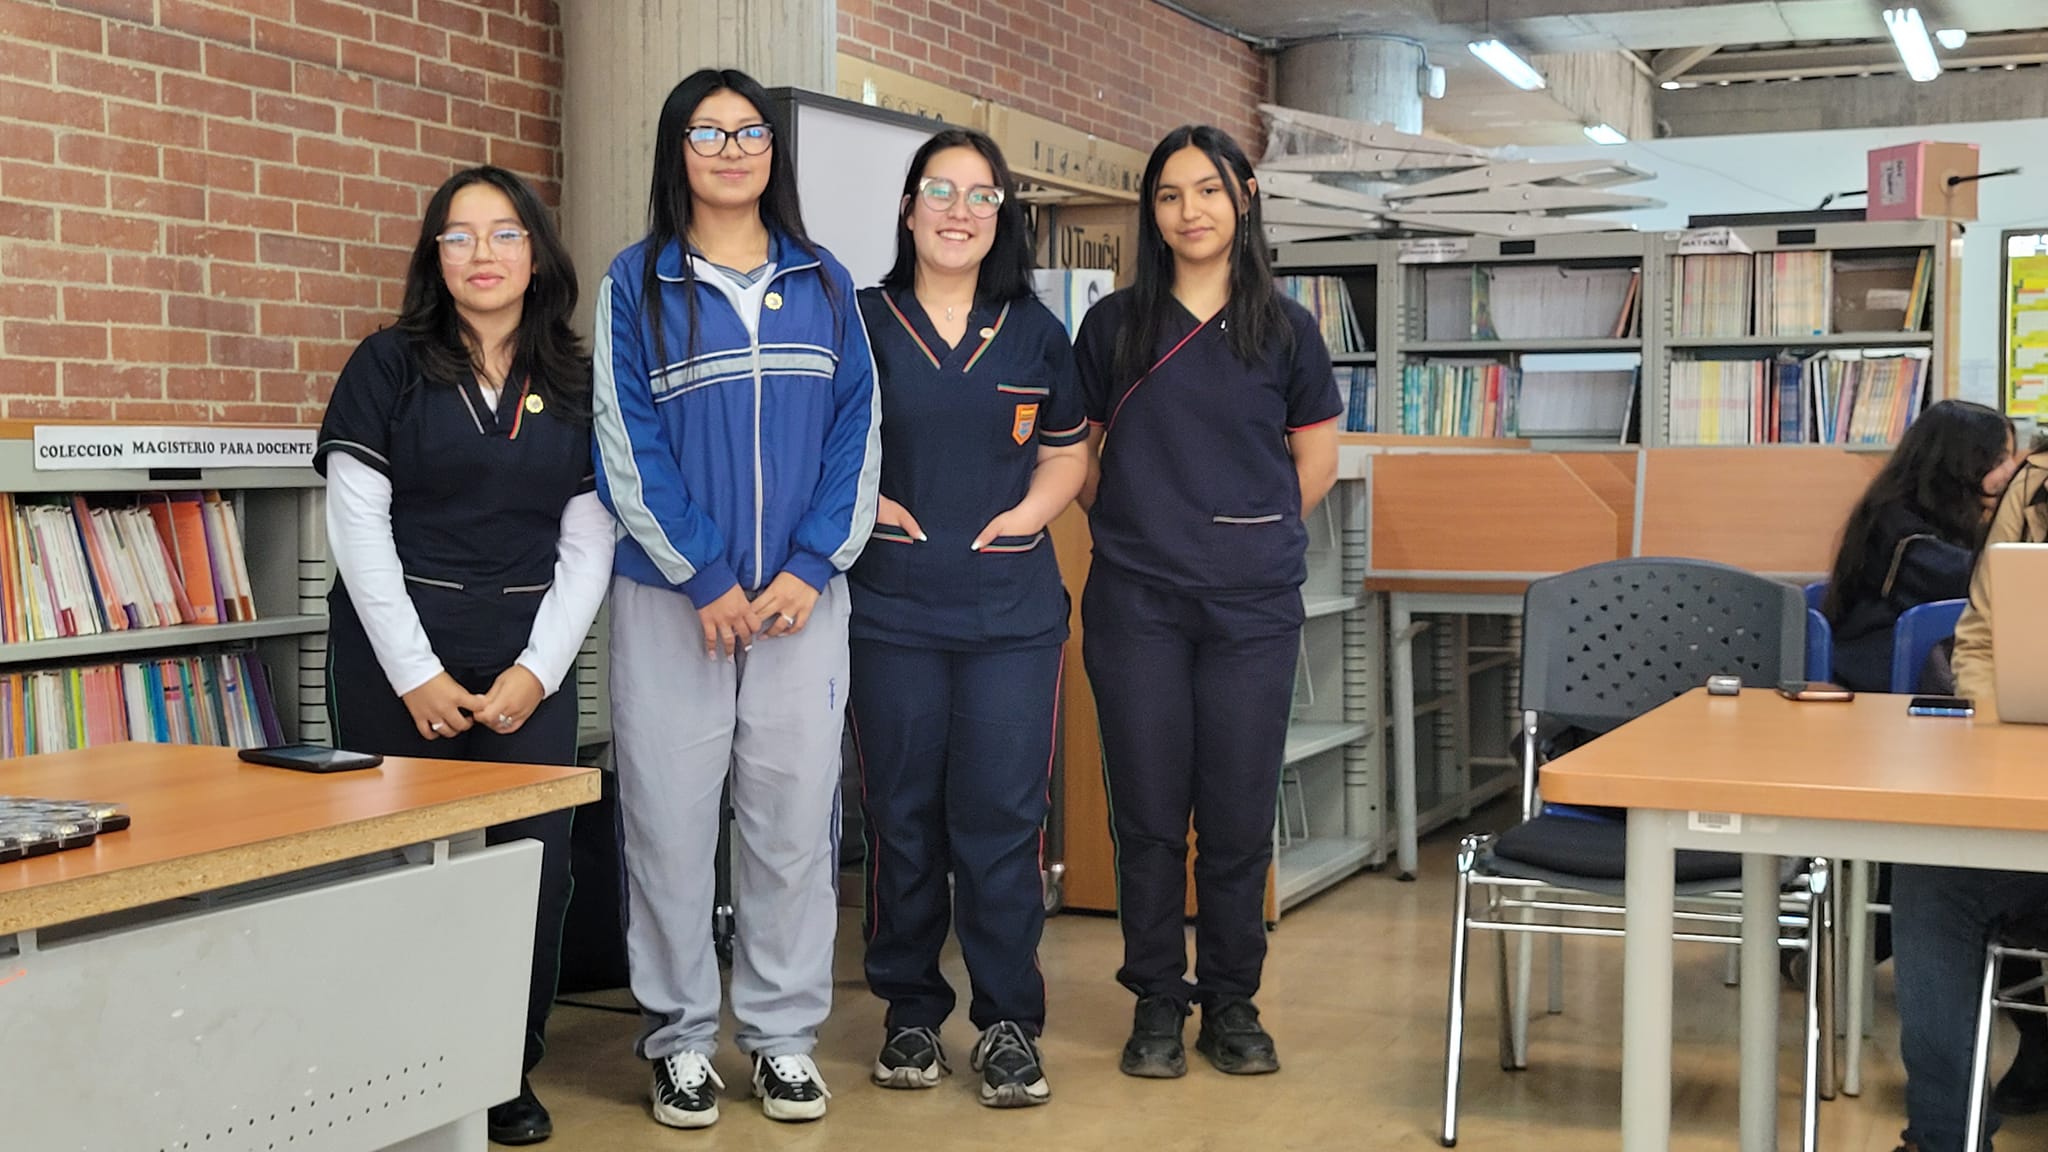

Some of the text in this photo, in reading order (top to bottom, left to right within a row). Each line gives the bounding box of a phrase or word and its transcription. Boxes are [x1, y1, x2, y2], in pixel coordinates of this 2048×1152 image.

[39, 440, 314, 458] COLECCION MAGISTERIO PARA DOCENTE
